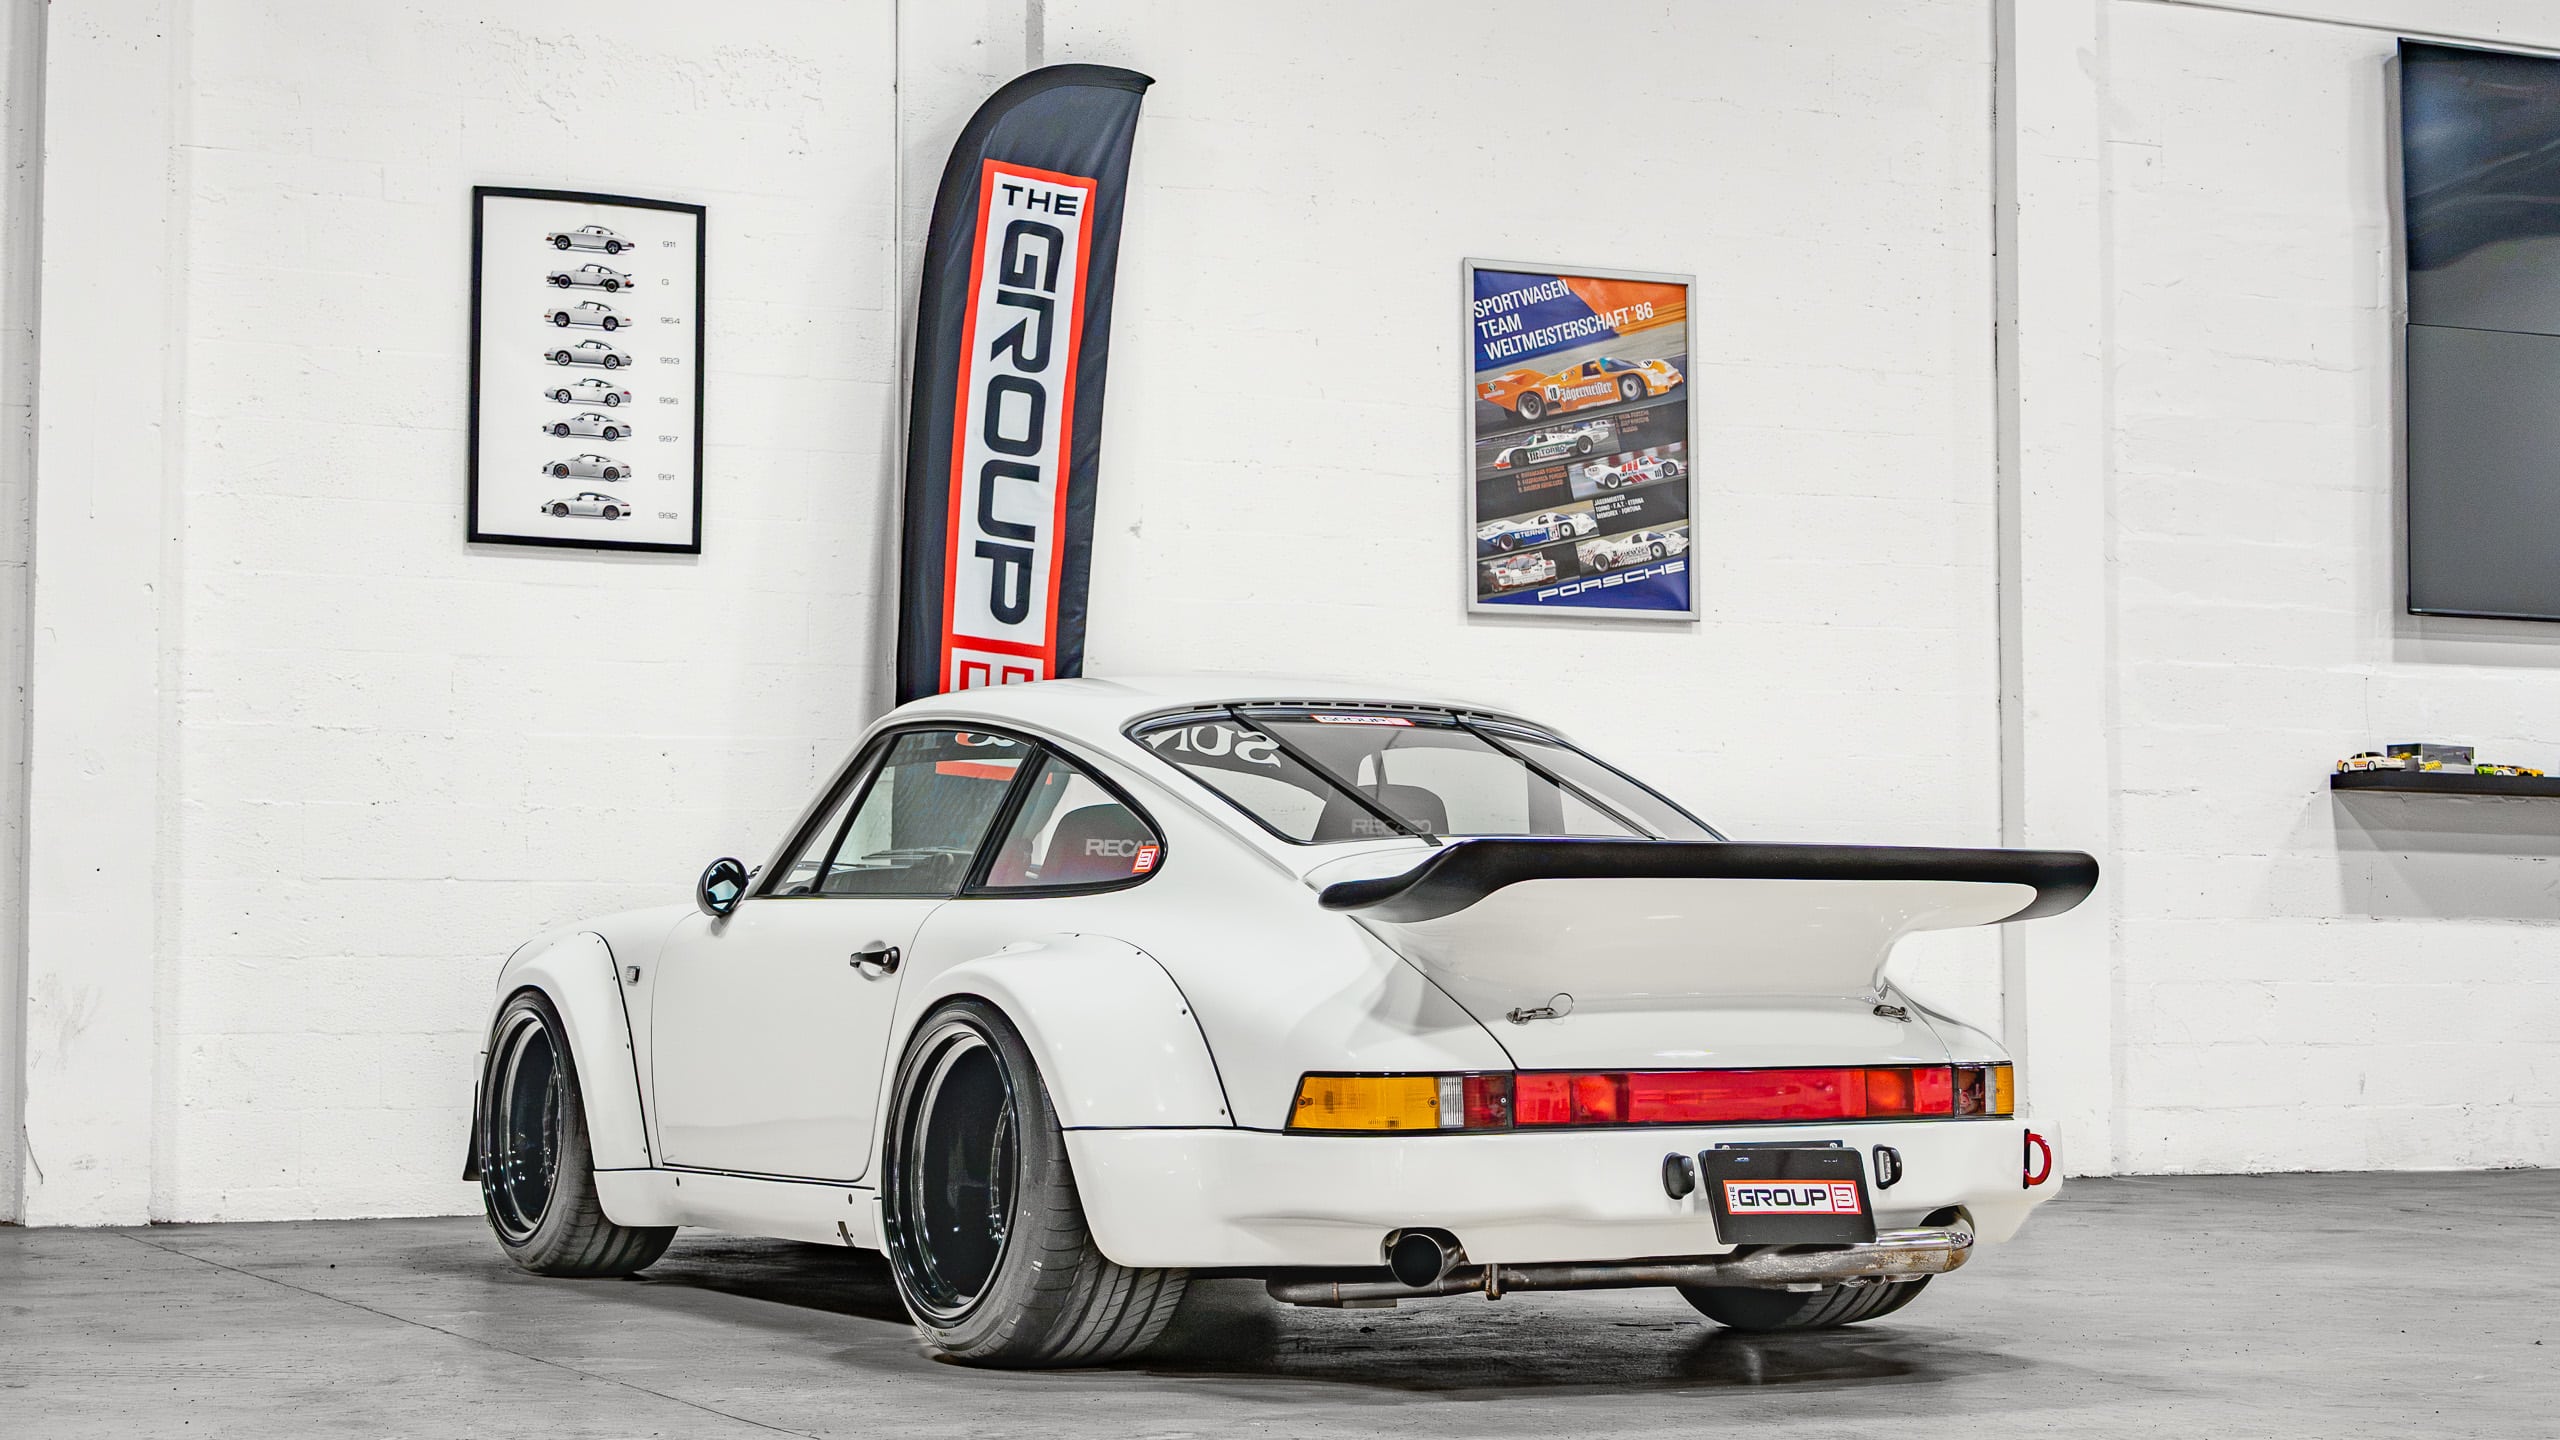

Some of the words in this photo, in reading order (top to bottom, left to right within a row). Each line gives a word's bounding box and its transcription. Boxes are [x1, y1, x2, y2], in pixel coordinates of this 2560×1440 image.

[1002, 184, 1078, 216] THE
[661, 278, 670, 286] G
[1473, 279, 1570, 318] SPORTWAGEN
[660, 316, 681, 325] 964
[1478, 313, 1522, 338] TEAM
[1484, 307, 1628, 360] WELTMEISTERSCHAFT
[1631, 301, 1654, 321] '86
[660, 356, 680, 365] 993
[976, 219, 1064, 625] GROUP
[658, 435, 679, 443] 997
[658, 473, 675, 481] 991
[658, 511, 679, 520] 992
[1537, 560, 1686, 602] PORSCHE
[1728, 1186, 1738, 1209] THE
[1737, 1188, 1827, 1207] GROUP
